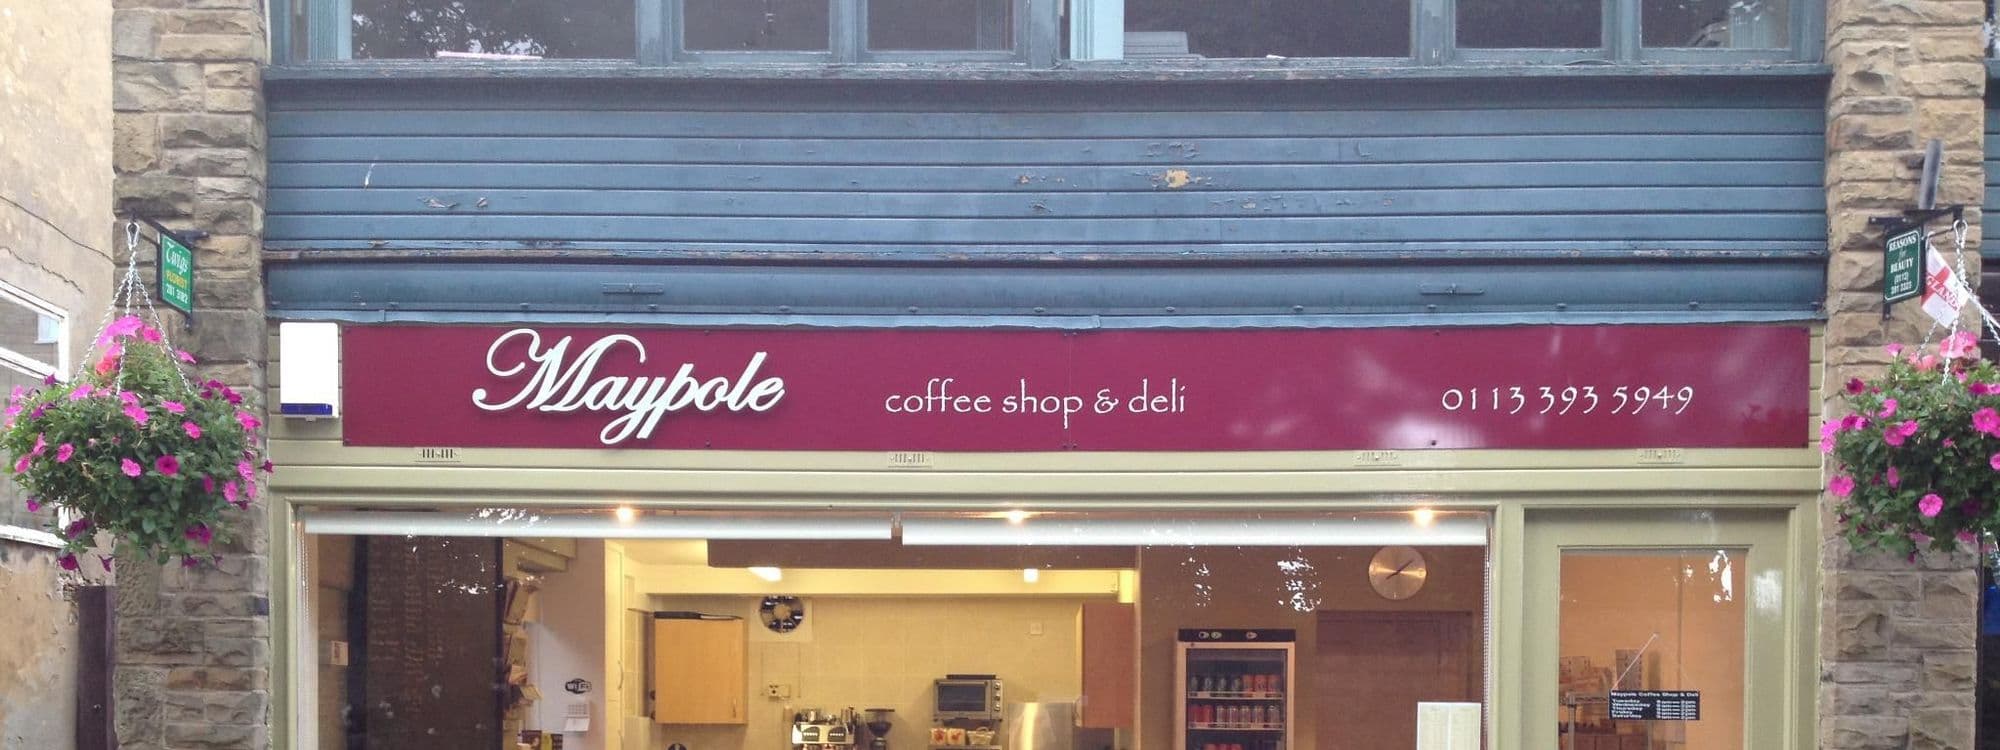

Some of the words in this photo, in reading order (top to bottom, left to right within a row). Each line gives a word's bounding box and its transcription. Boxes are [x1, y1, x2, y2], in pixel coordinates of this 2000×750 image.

[1888, 234, 1917, 253] REASONS
[166, 241, 189, 276] Twigs
[1890, 257, 1914, 274] BEAUTY
[166, 269, 188, 290] FLORIST
[472, 328, 786, 445] Maypole
[1442, 386, 1526, 414] 0113
[1539, 386, 1599, 415] 393
[1611, 386, 1694, 415] 5949
[885, 378, 992, 413] coffee
[1002, 378, 1084, 430] shop
[1094, 387, 1119, 414] &
[1128, 378, 1186, 413] deli
